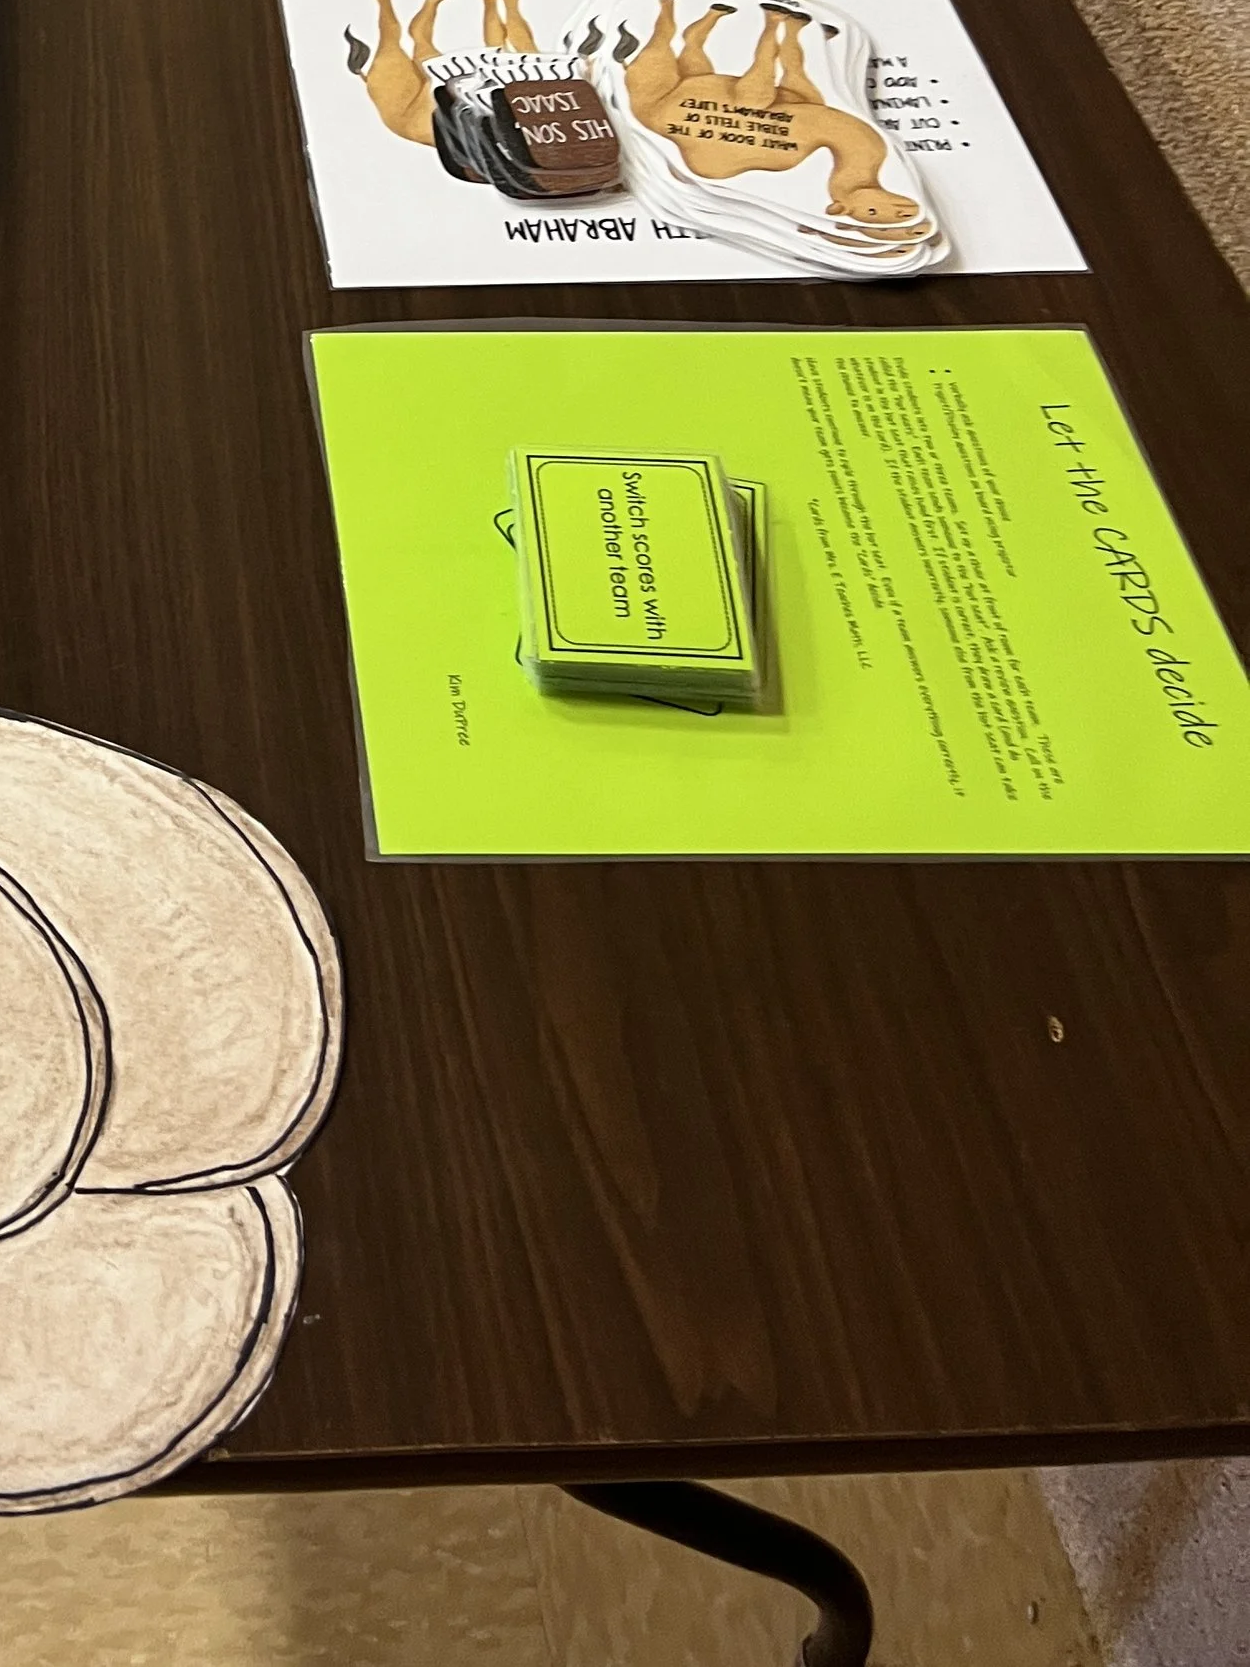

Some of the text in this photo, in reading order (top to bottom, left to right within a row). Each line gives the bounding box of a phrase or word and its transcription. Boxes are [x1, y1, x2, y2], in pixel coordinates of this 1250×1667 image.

[508, 91, 581, 113] ISAAC
[679, 98, 718, 111] LIFE?
[513, 119, 614, 145] HIS SON,
[683, 112, 789, 136] BIBLE TELLS OF
[666, 123, 798, 151] WHAT BOOK OF THE
[505, 218, 635, 242] ABRAHAM
[597, 488, 630, 618] another team
[622, 471, 666, 640] Switch scores with
[1040, 404, 1216, 747] Let the CARDS decide
[447, 674, 462, 697] Kim
